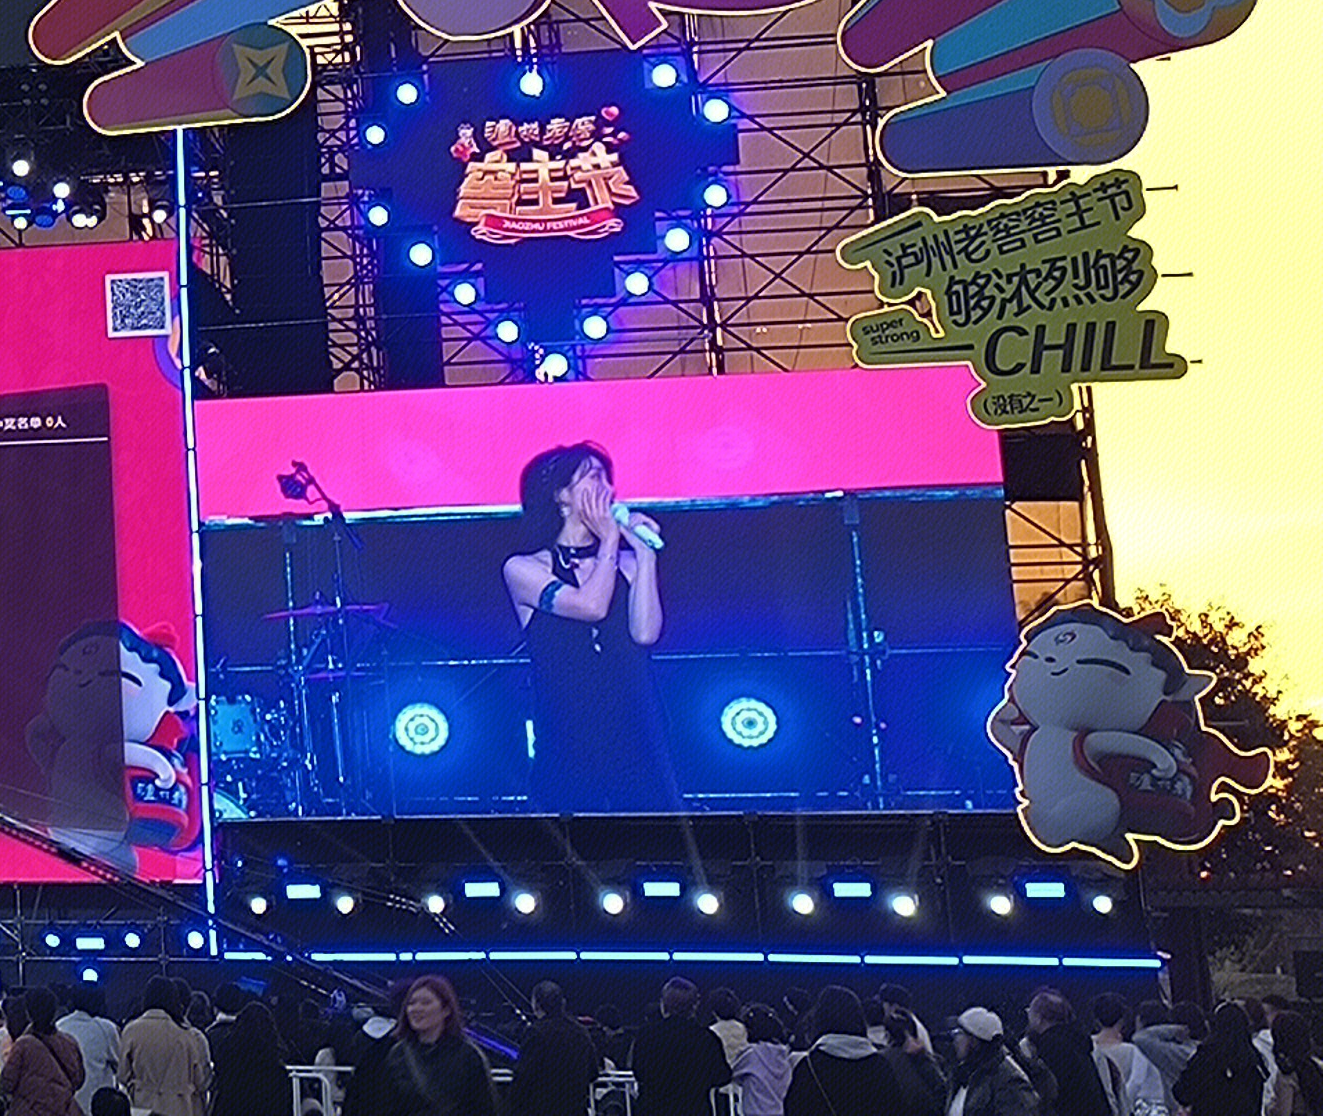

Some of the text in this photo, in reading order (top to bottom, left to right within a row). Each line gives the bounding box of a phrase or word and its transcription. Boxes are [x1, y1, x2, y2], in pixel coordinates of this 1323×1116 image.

[883, 176, 1135, 289] 泸州老窖窖主节
[944, 244, 1146, 329] 够浓烈够
[861, 317, 905, 336] super
[870, 329, 921, 346] strong
[983, 319, 1175, 377] CHILL
